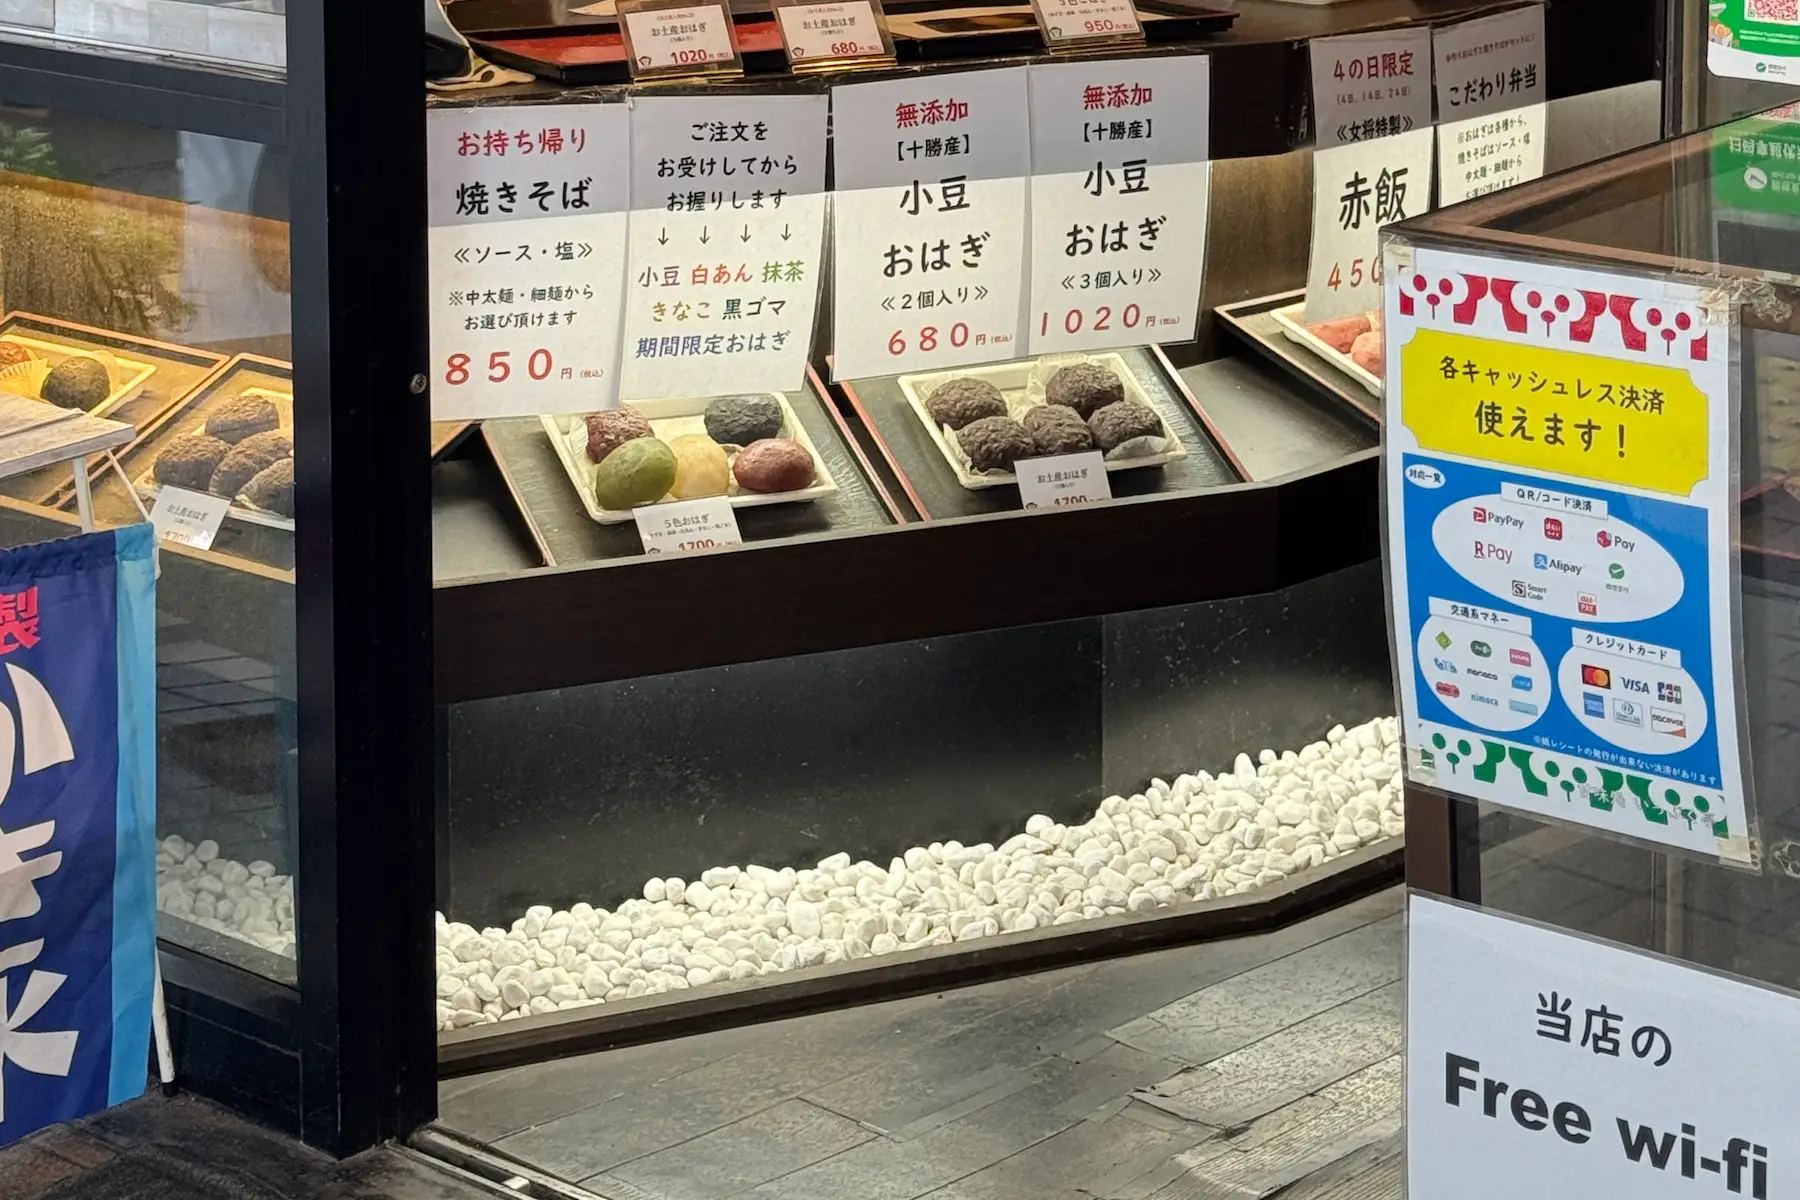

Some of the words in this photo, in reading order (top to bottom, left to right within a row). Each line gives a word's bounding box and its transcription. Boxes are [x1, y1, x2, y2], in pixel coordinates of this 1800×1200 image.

[1084, 20, 1114, 32] 950
[670, 49, 708, 65] 1020
[831, 42, 858, 55] 680
[1333, 50, 1415, 82] 4の日限定
[1083, 83, 1153, 111] 無添加
[1449, 63, 1537, 107] こだわり弁当
[895, 98, 969, 129] 無添加
[457, 128, 587, 157] お持ち帰り
[691, 121, 769, 142] ご注文を
[1084, 119, 1152, 143] 【十勝産】
[897, 134, 970, 161] 【十勝産】
[657, 155, 798, 179] お受けしてから
[1083, 158, 1150, 197] 小豆
[456, 177, 593, 216] 焼きそば
[667, 189, 788, 212] お握りします
[899, 175, 971, 216] 小豆
[1339, 166, 1409, 231] 赤飯
[1065, 215, 1168, 257] おはぎ
[883, 231, 991, 278] おはぎ
[638, 265, 681, 288] 小豆
[691, 264, 753, 286] 白あん
[762, 260, 805, 284] 抹茶
[464, 310, 578, 331] お選び頂けます
[652, 301, 711, 322] きなこ
[722, 298, 786, 320] 黒ゴマ
[636, 330, 791, 359] 期間限定おはぎ
[1439, 355, 1666, 416] 各キャッシュレス決済
[1474, 399, 1627, 459] 使えます！
[1516, 488, 1593, 513] QR/コード決済
[1488, 512, 1525, 529] PayPay
[1614, 535, 1636, 552] Pay
[1549, 559, 1583, 576] Alipay
[1450, 604, 1509, 624] 交通系マネー
[1585, 633, 1668, 660] クレジットカード
[1619, 676, 1650, 694] VISA
[1536, 991, 1672, 1067] 当店の
[1445, 1052, 1593, 1146] Free
[1615, 1115, 1768, 1200] wi-fi
